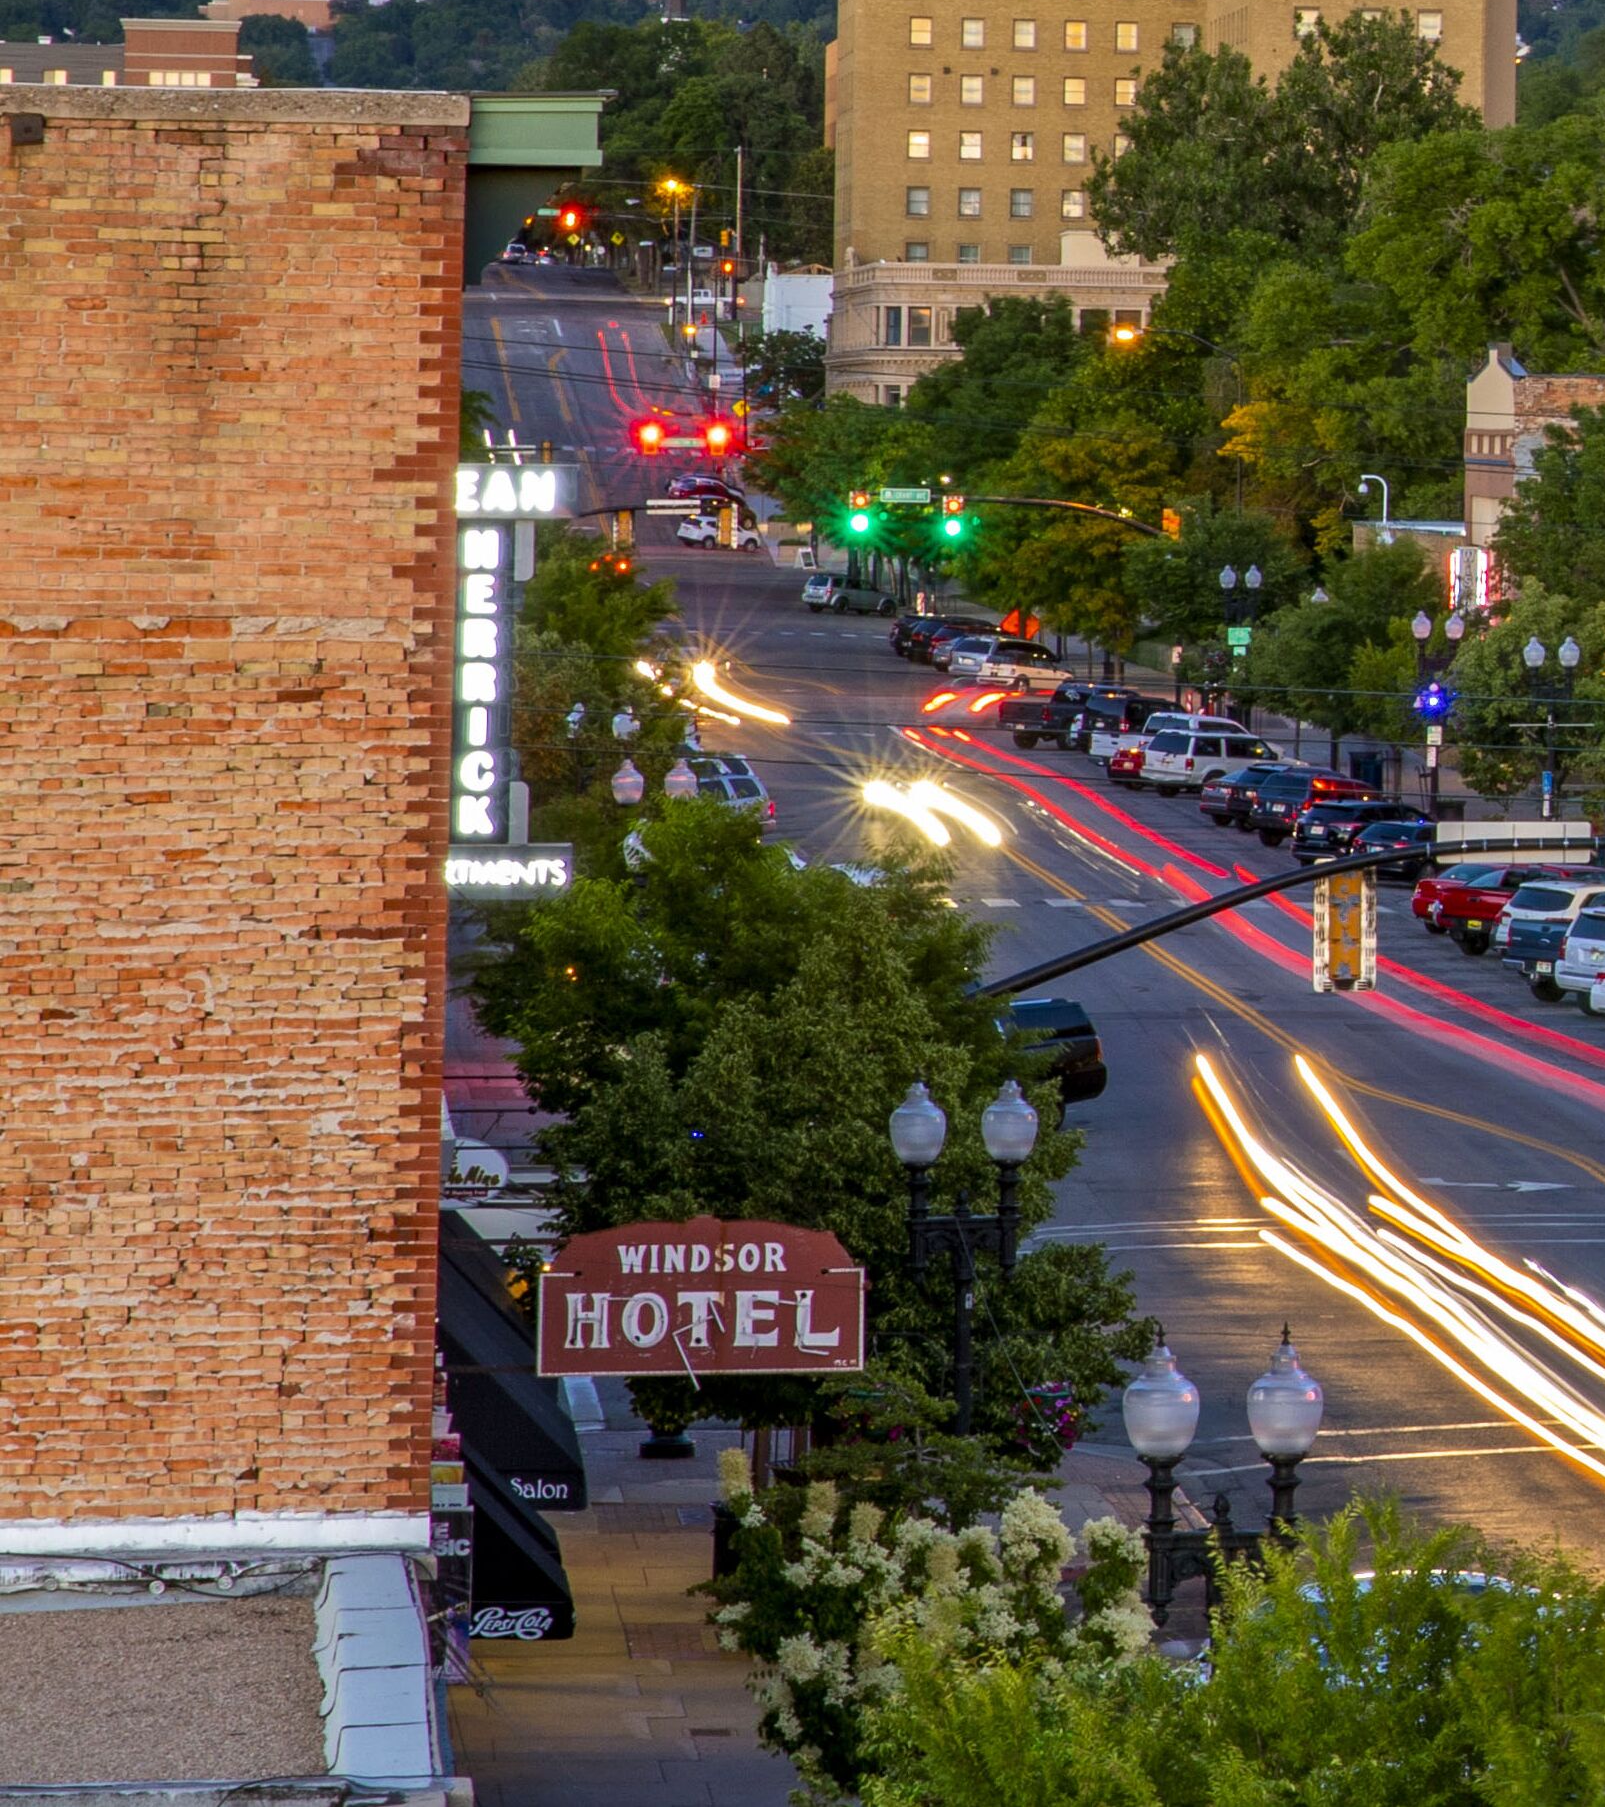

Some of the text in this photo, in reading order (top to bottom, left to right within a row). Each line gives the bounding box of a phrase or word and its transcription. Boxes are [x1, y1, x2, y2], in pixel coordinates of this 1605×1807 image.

[617, 1242, 787, 1274] WINDSOR
[564, 1290, 840, 1349] HOTEL
[510, 1477, 568, 1500] Salon
